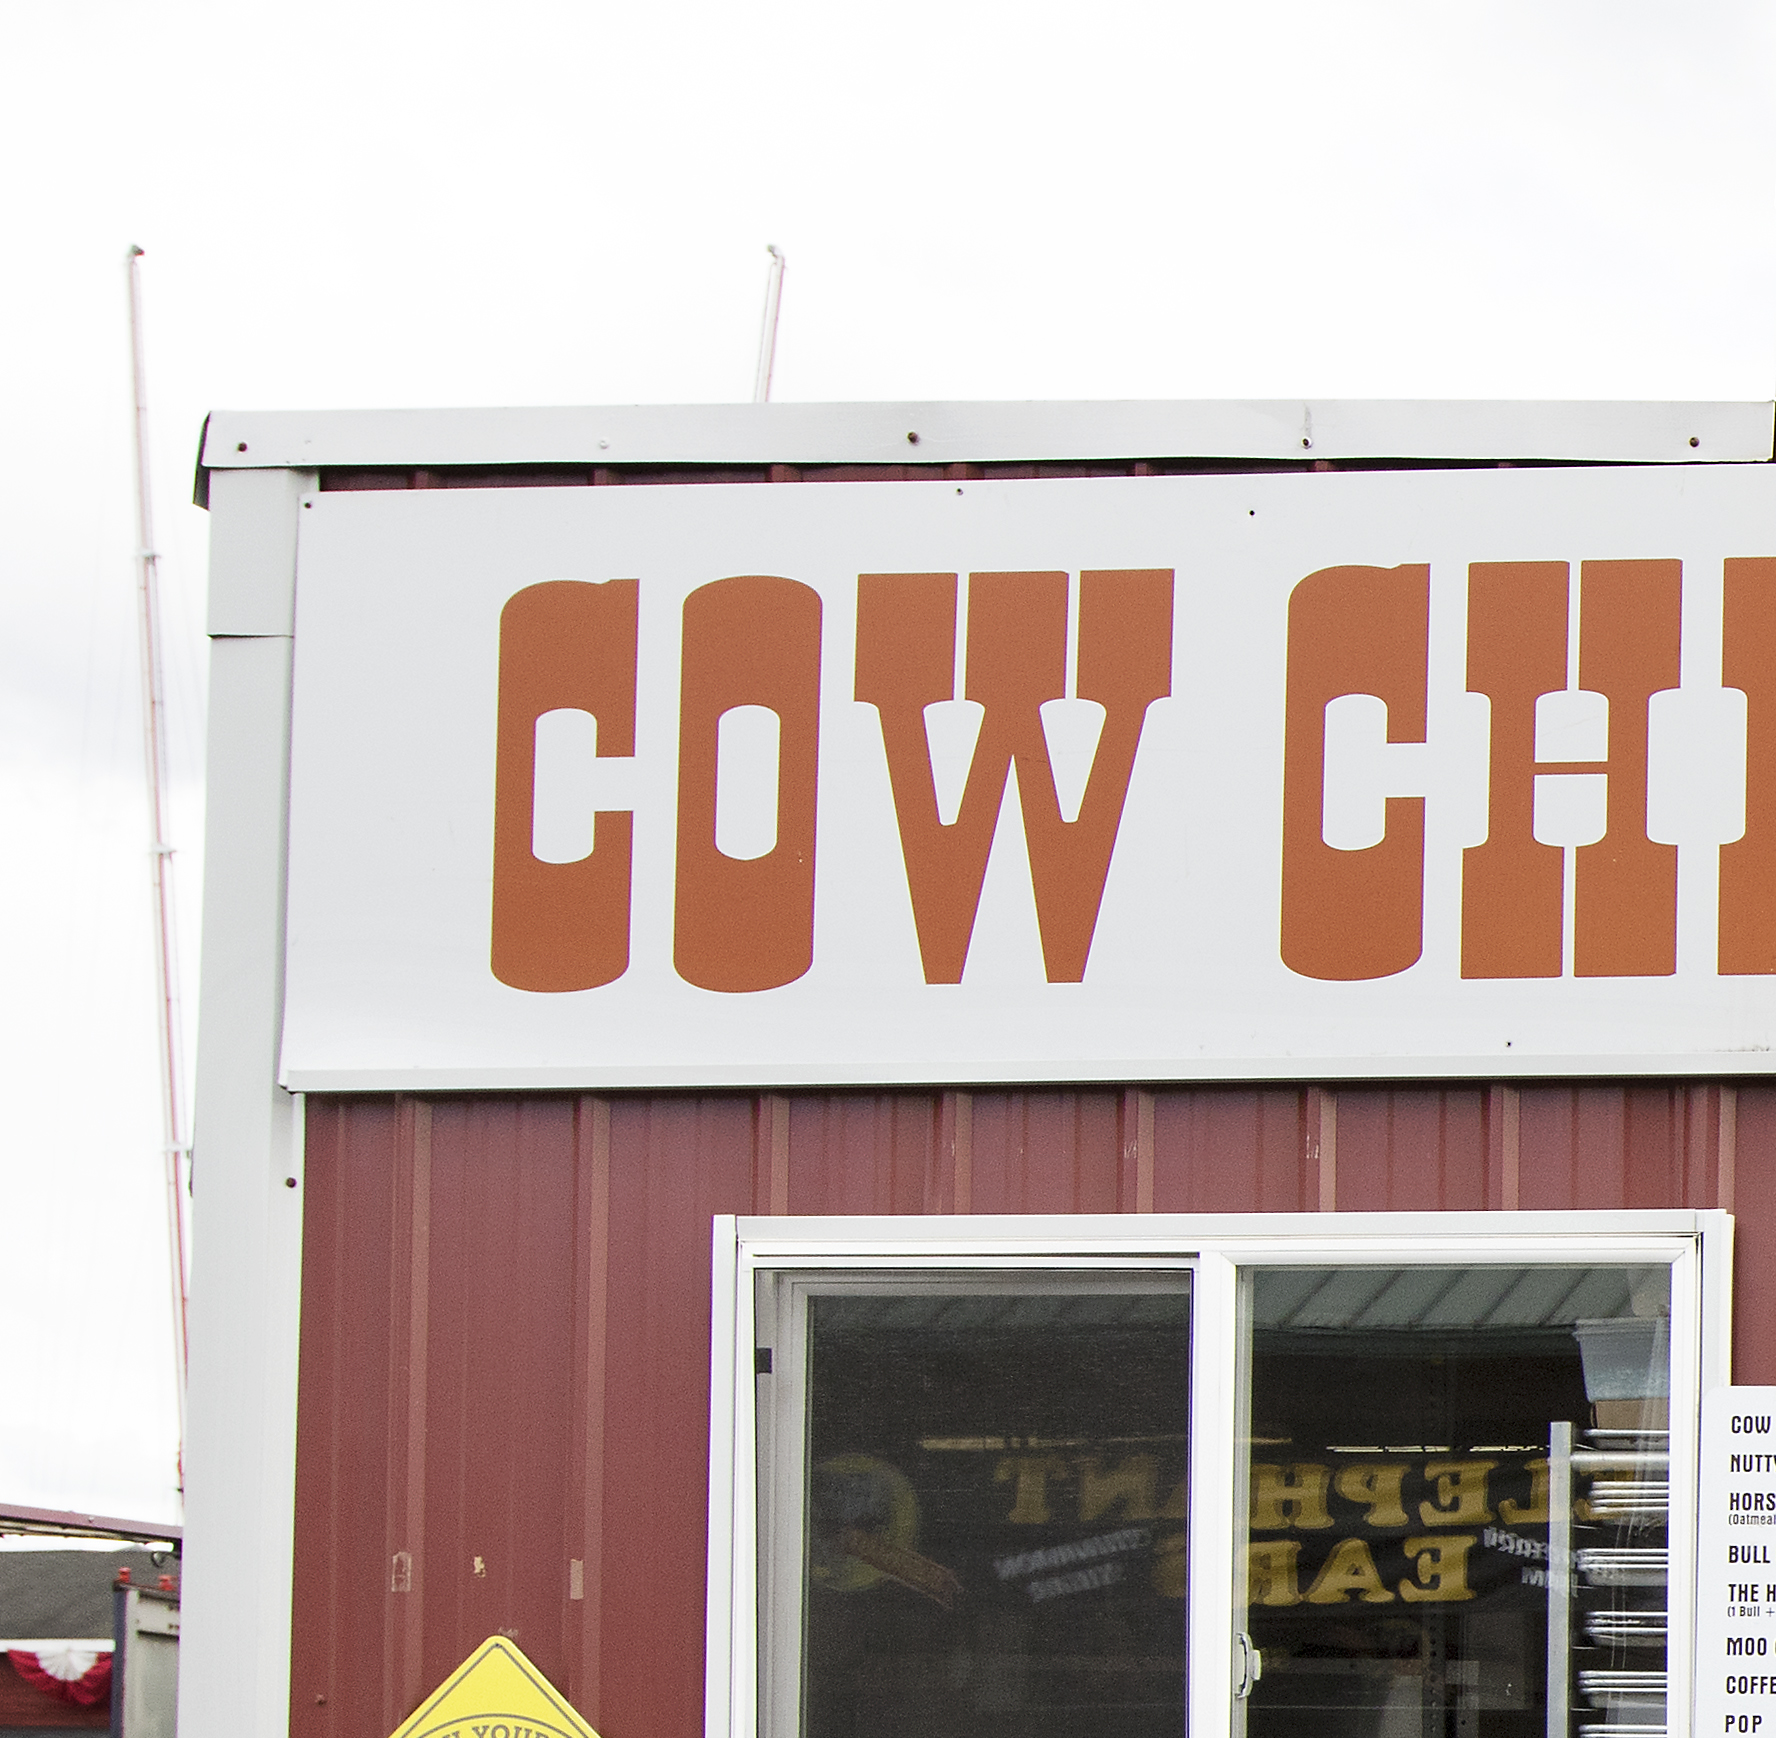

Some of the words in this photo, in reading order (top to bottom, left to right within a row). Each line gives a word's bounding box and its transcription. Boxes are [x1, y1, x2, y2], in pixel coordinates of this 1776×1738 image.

[490, 569, 1175, 992] COW
[1732, 1416, 1770, 1433] COW
[1729, 1546, 1770, 1563] BULL
[1729, 1584, 1758, 1602] THE
[1727, 1638, 1766, 1655] MOO
[1726, 1715, 1761, 1733] POP
